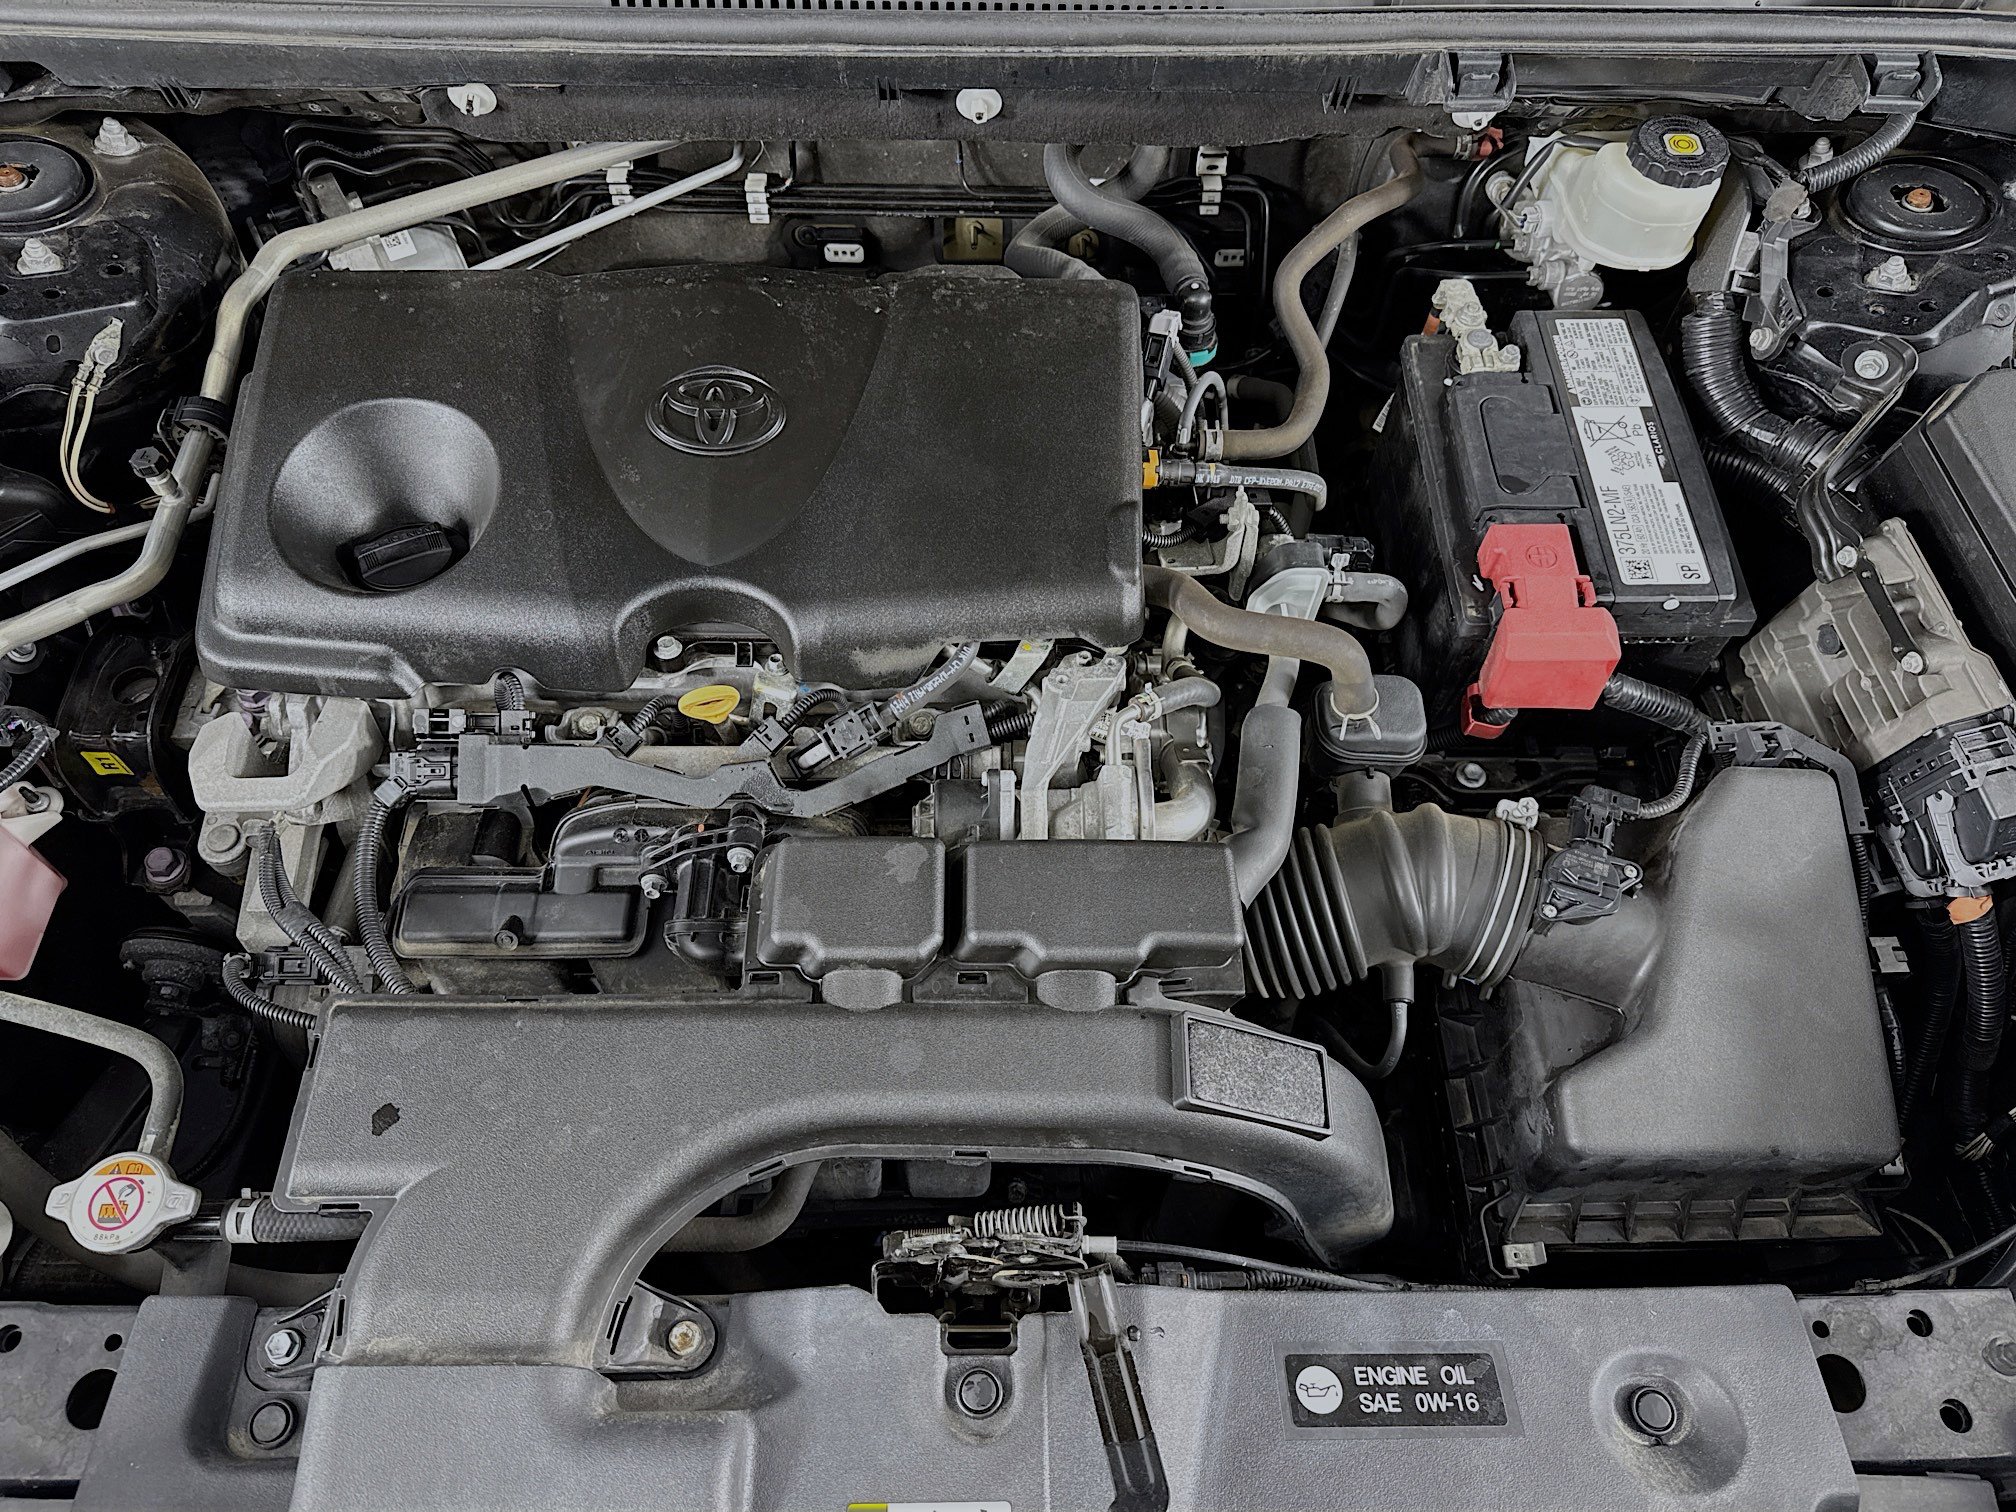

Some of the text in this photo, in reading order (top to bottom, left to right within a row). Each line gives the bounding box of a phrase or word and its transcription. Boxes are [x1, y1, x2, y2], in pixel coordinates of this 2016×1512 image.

[1631, 423, 1643, 437] Pb
[1646, 421, 1663, 455] CLARIOS
[1600, 485, 1636, 555] 375LN2-MF
[1680, 565, 1701, 580] SP
[95, 757, 120, 770] R1
[94, 1233, 120, 1241] 88kPa
[1353, 1365, 1475, 1387] ENGINE OIL
[1358, 1391, 1480, 1414] SAE 0W-16
